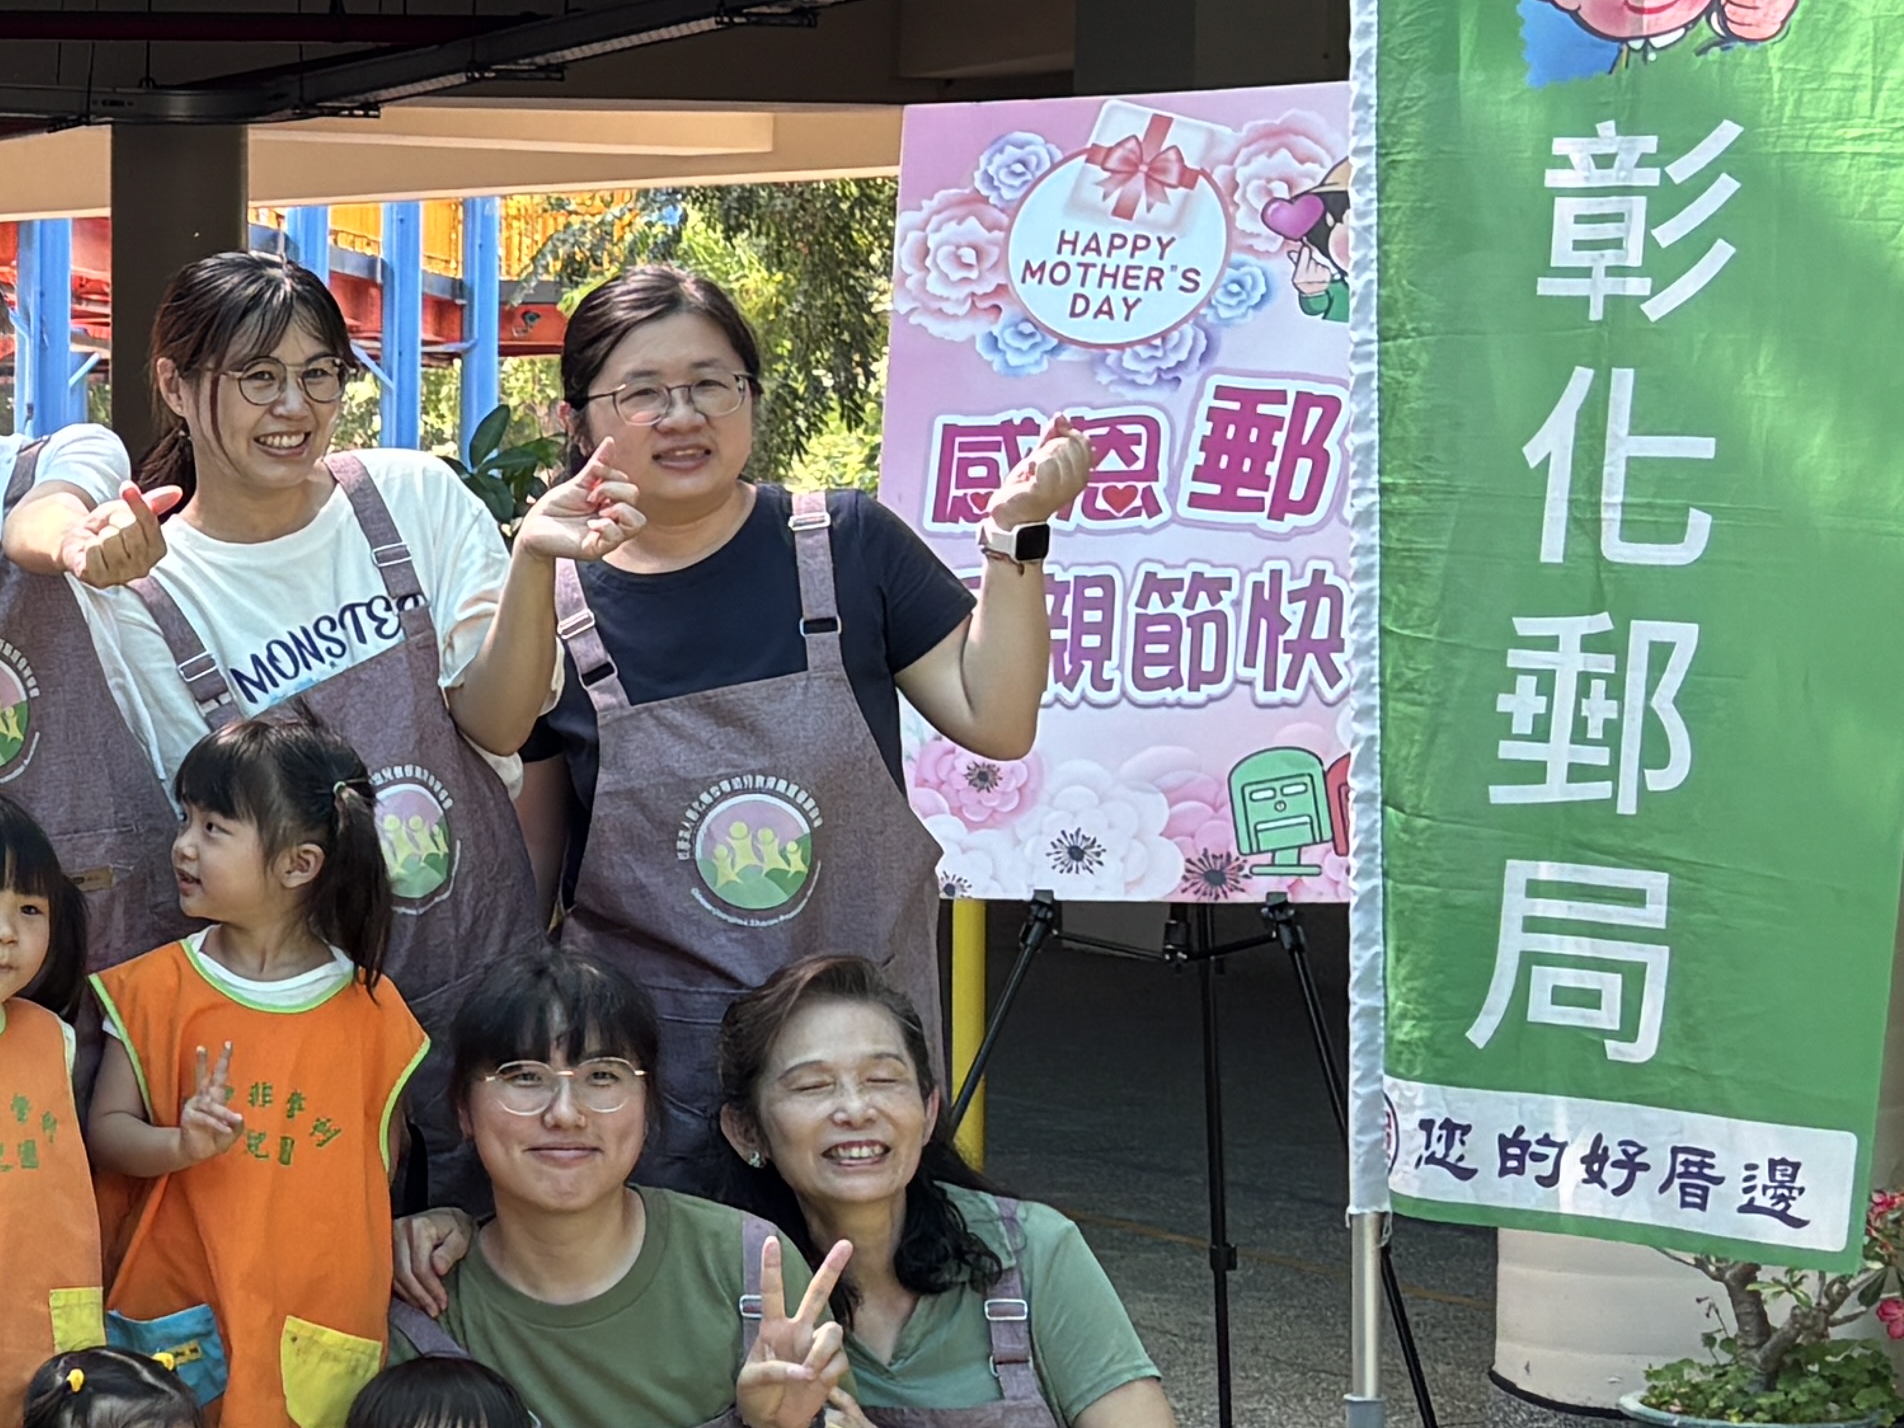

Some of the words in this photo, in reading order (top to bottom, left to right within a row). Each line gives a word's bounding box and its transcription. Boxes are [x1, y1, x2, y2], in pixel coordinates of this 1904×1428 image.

[1056, 229, 1177, 261] HAPPY
[1068, 292, 1143, 322] DAY
[1464, 118, 1744, 1062] 彰化郵局
[1414, 1116, 1811, 1229] 您的好厝邊
